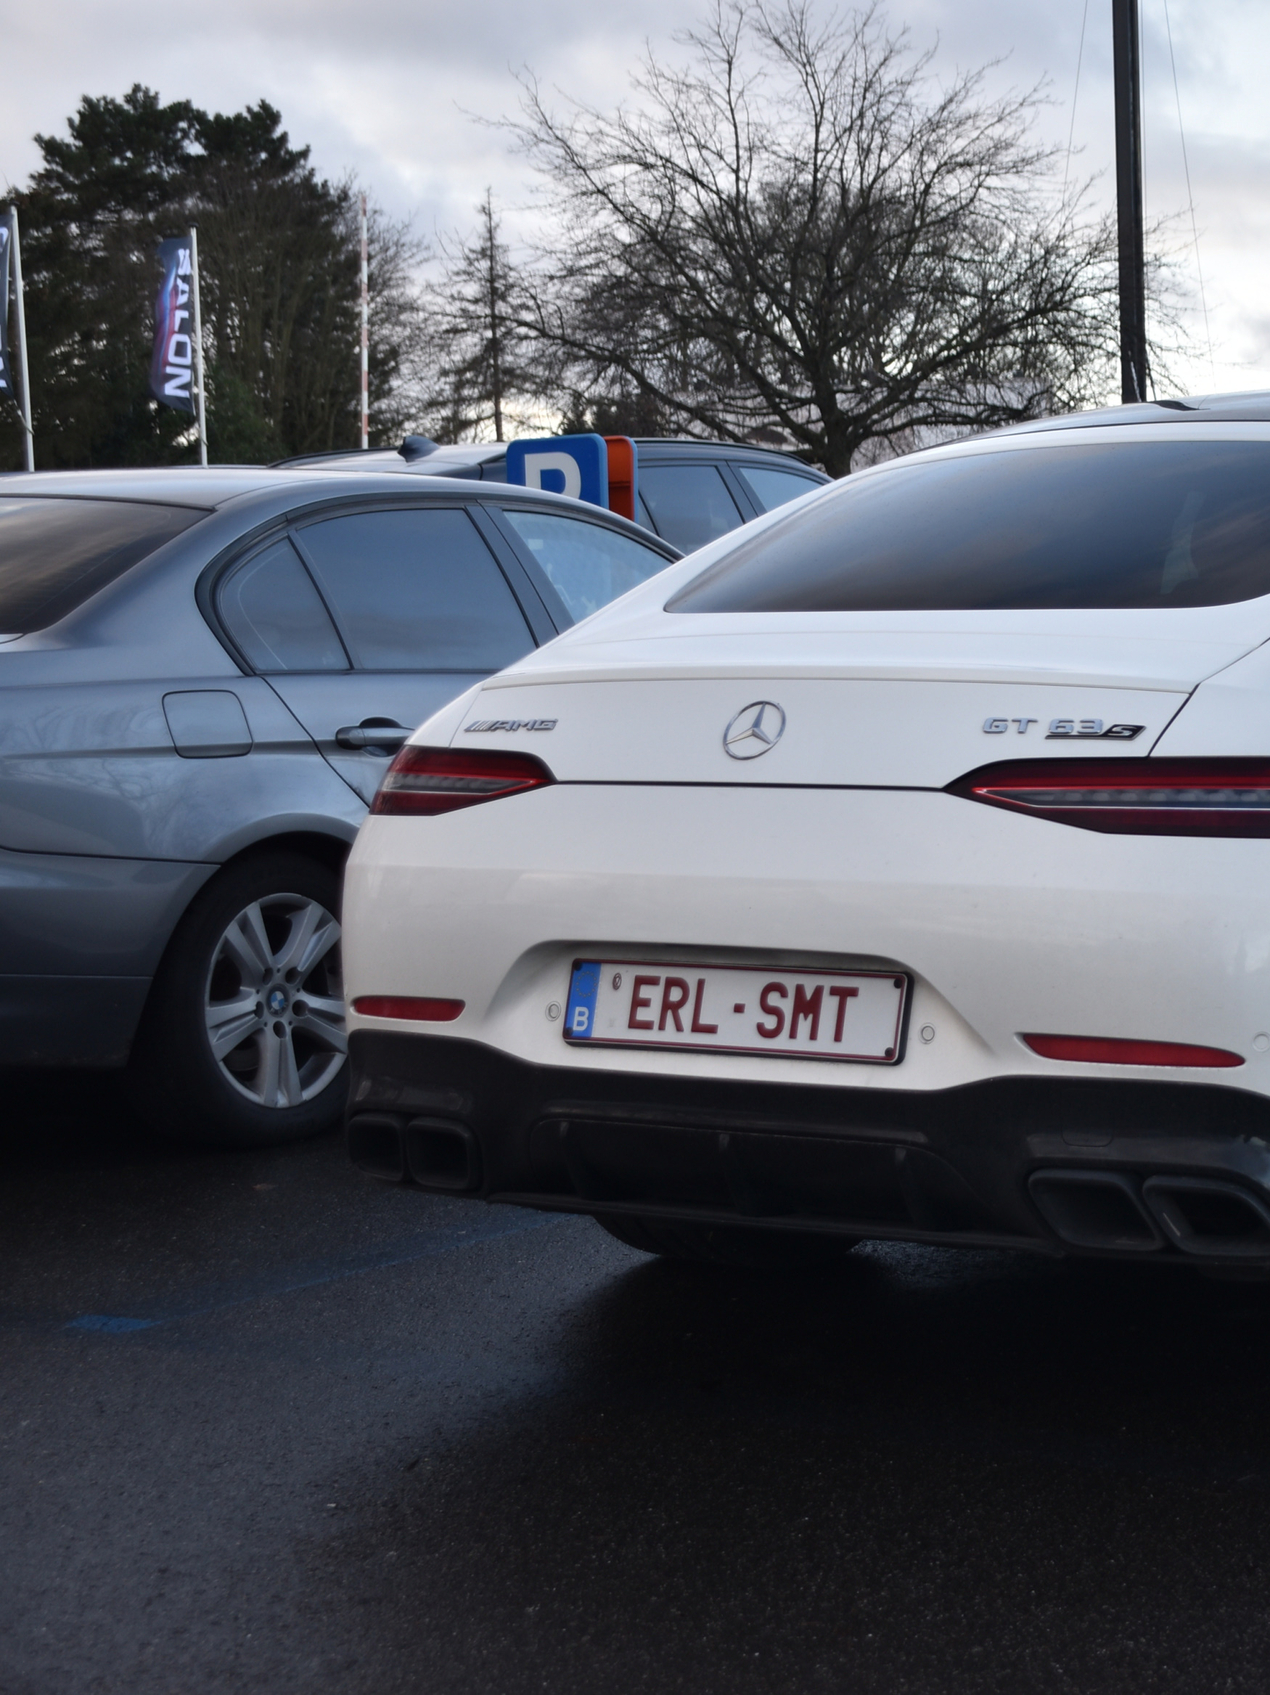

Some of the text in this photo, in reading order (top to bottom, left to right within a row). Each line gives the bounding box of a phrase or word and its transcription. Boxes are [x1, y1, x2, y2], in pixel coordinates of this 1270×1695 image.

[524, 451, 582, 500] P
[488, 719, 559, 732] AMG
[982, 717, 1038, 734] GT
[572, 1006, 590, 1031] B
